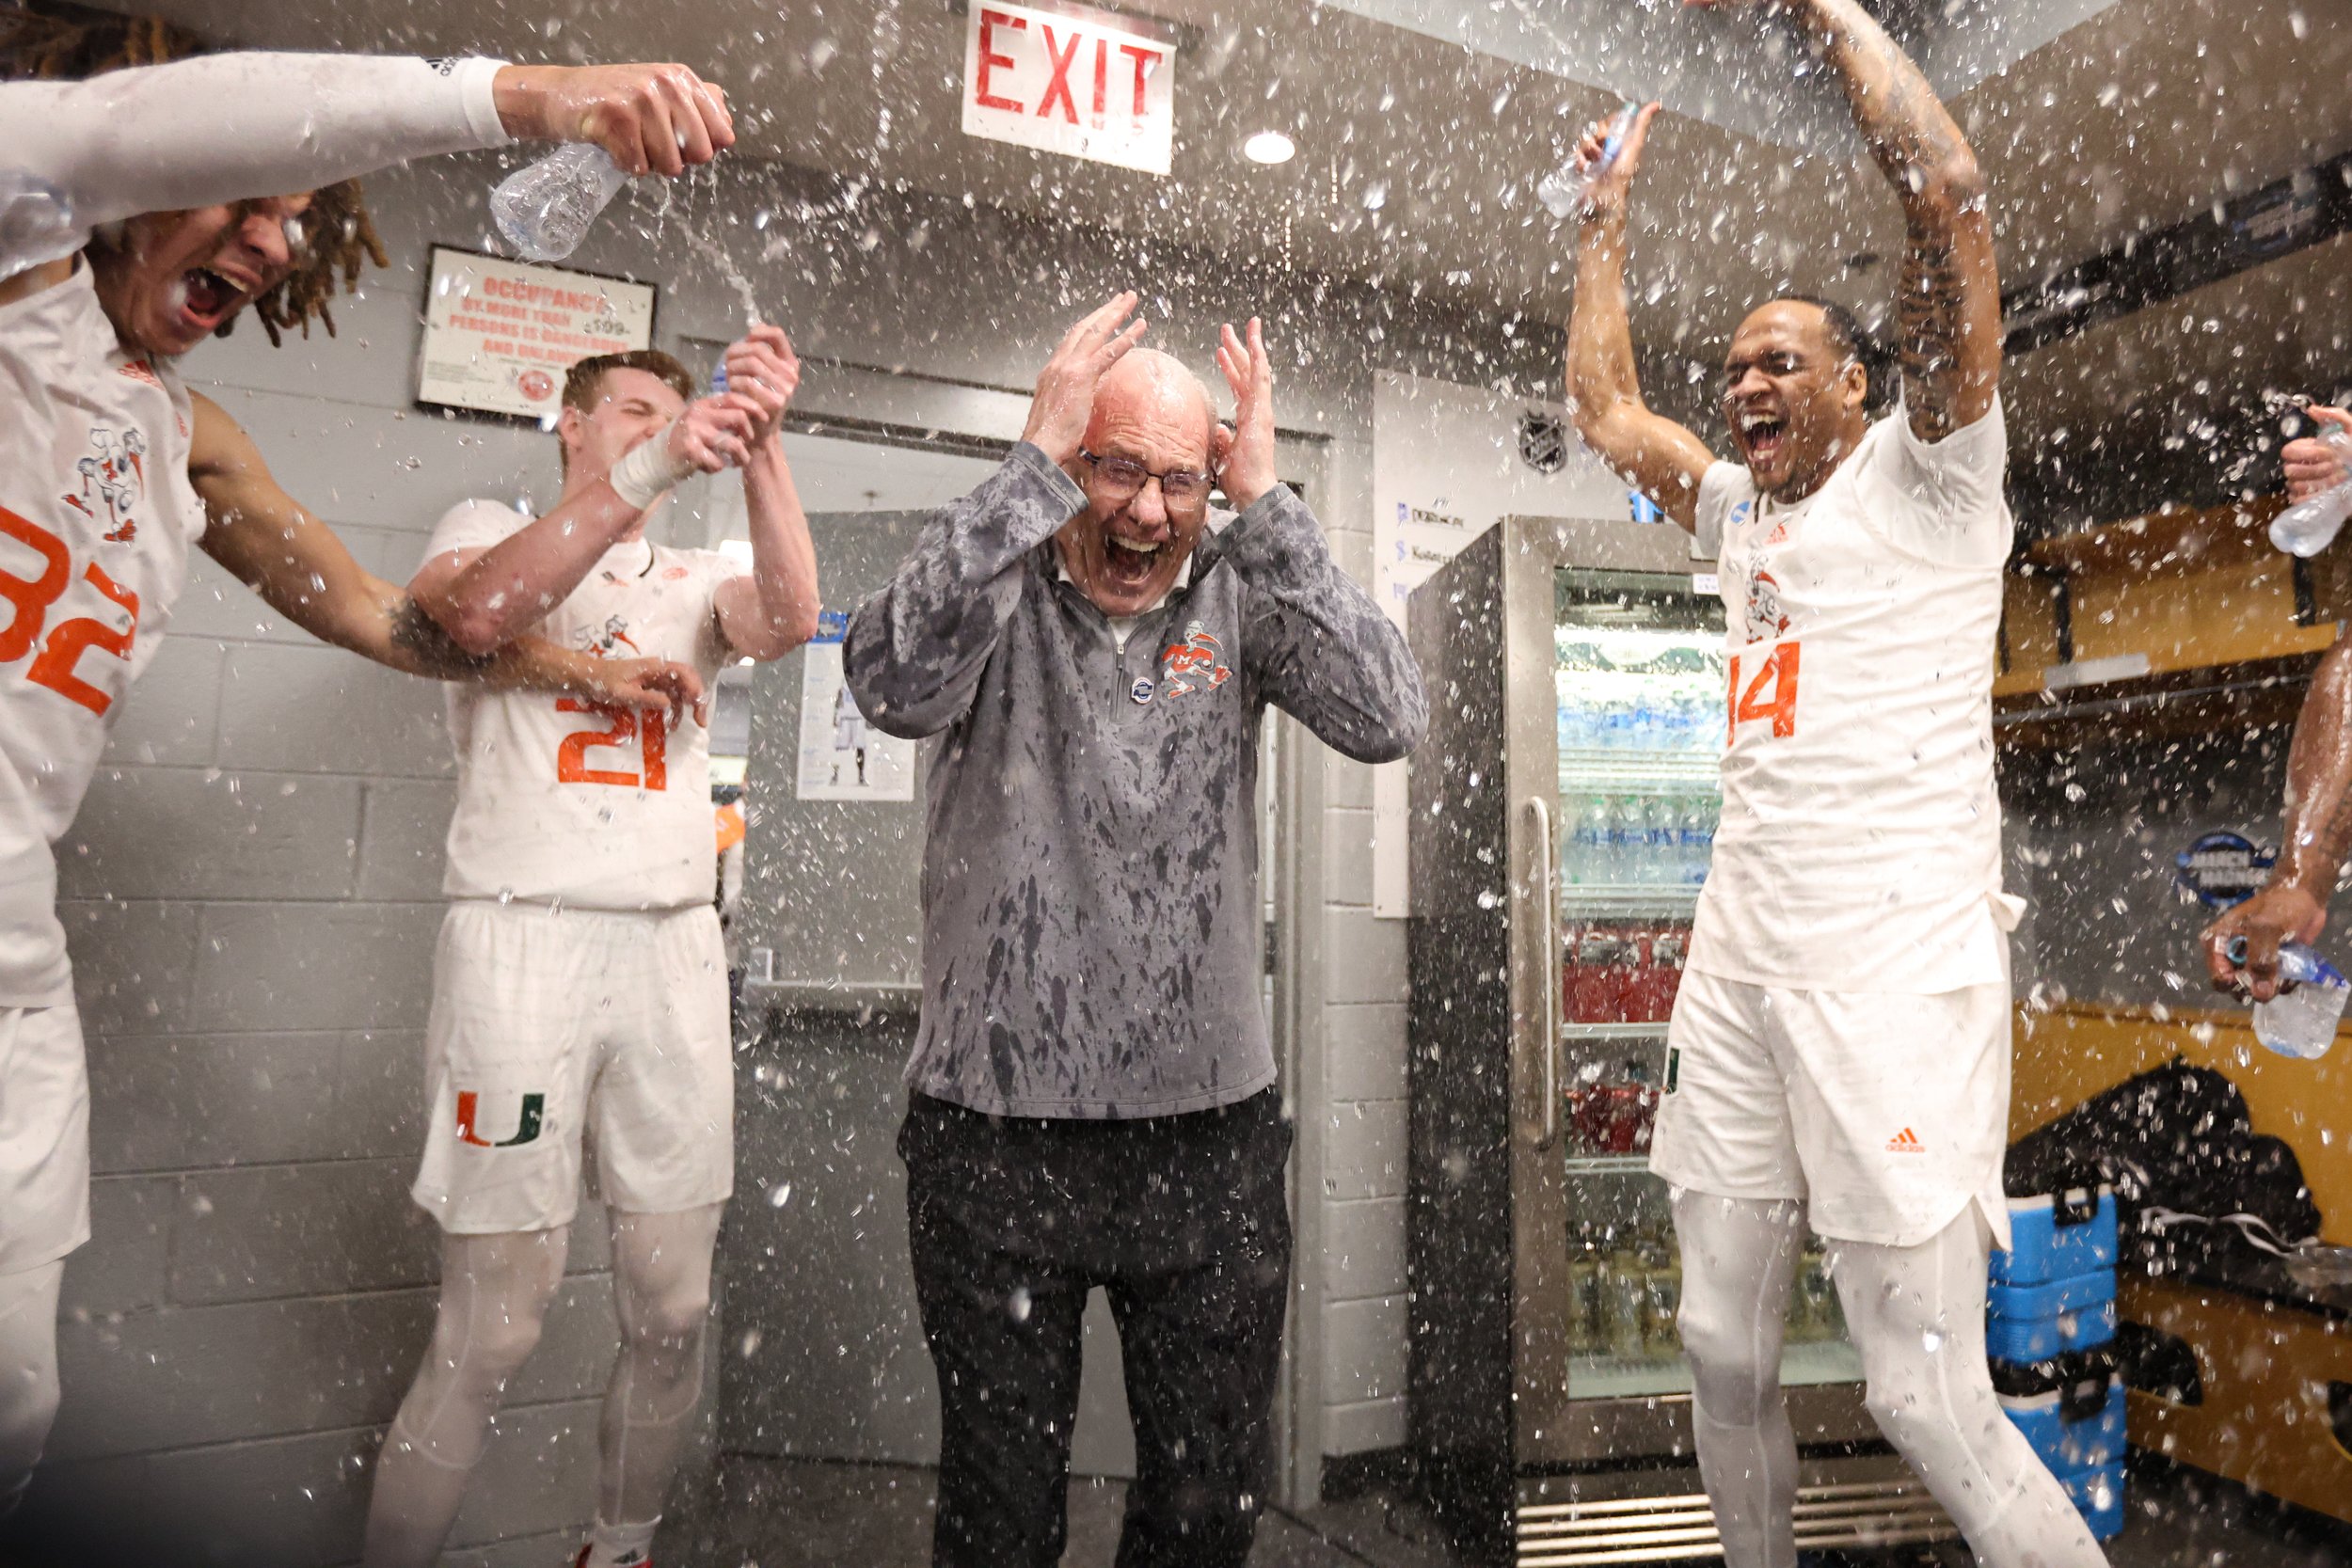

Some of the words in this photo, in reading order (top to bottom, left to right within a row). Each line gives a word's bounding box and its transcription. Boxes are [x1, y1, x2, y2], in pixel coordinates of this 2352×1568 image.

[977, 8, 1163, 125] EXIT
[1727, 641, 1800, 748] 14
[556, 698, 667, 791] 21
[456, 1091, 545, 1148] U
[1885, 1144, 1925, 1153] adidas
